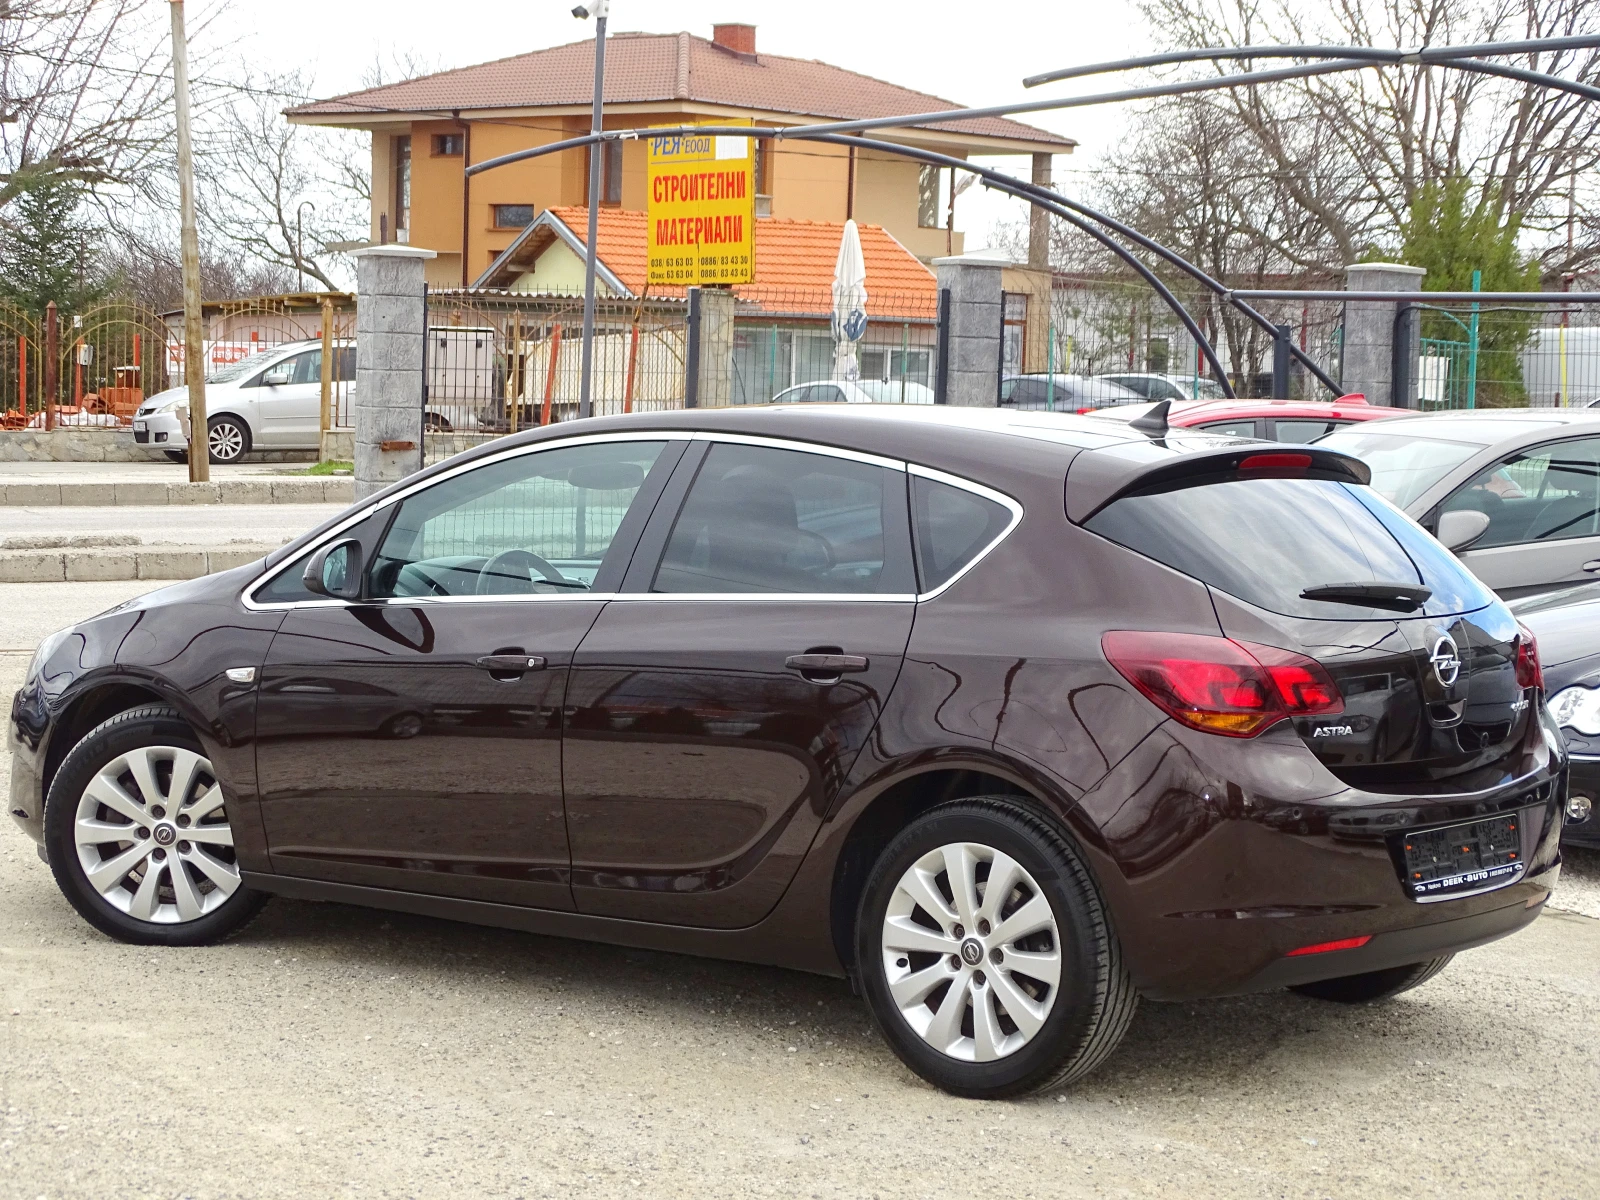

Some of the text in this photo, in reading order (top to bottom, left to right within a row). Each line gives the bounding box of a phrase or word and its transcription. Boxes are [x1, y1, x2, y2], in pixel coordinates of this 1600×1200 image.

[685, 138, 710, 154] ЕООД
[653, 171, 746, 203] СТРОИТЕЛНИ
[656, 215, 743, 246] МАТЕРИАЛИ
[666, 258, 674, 267] 63
[675, 257, 684, 266] 63
[685, 257, 693, 266] 03
[720, 256, 729, 265] 83
[730, 255, 739, 264] 43
[666, 270, 674, 279] 63
[675, 269, 684, 279] 63
[685, 269, 693, 278] 04
[720, 268, 729, 277] 83
[730, 268, 739, 277] 43
[740, 268, 748, 277] 43
[1313, 725, 1353, 738] ASTRA
